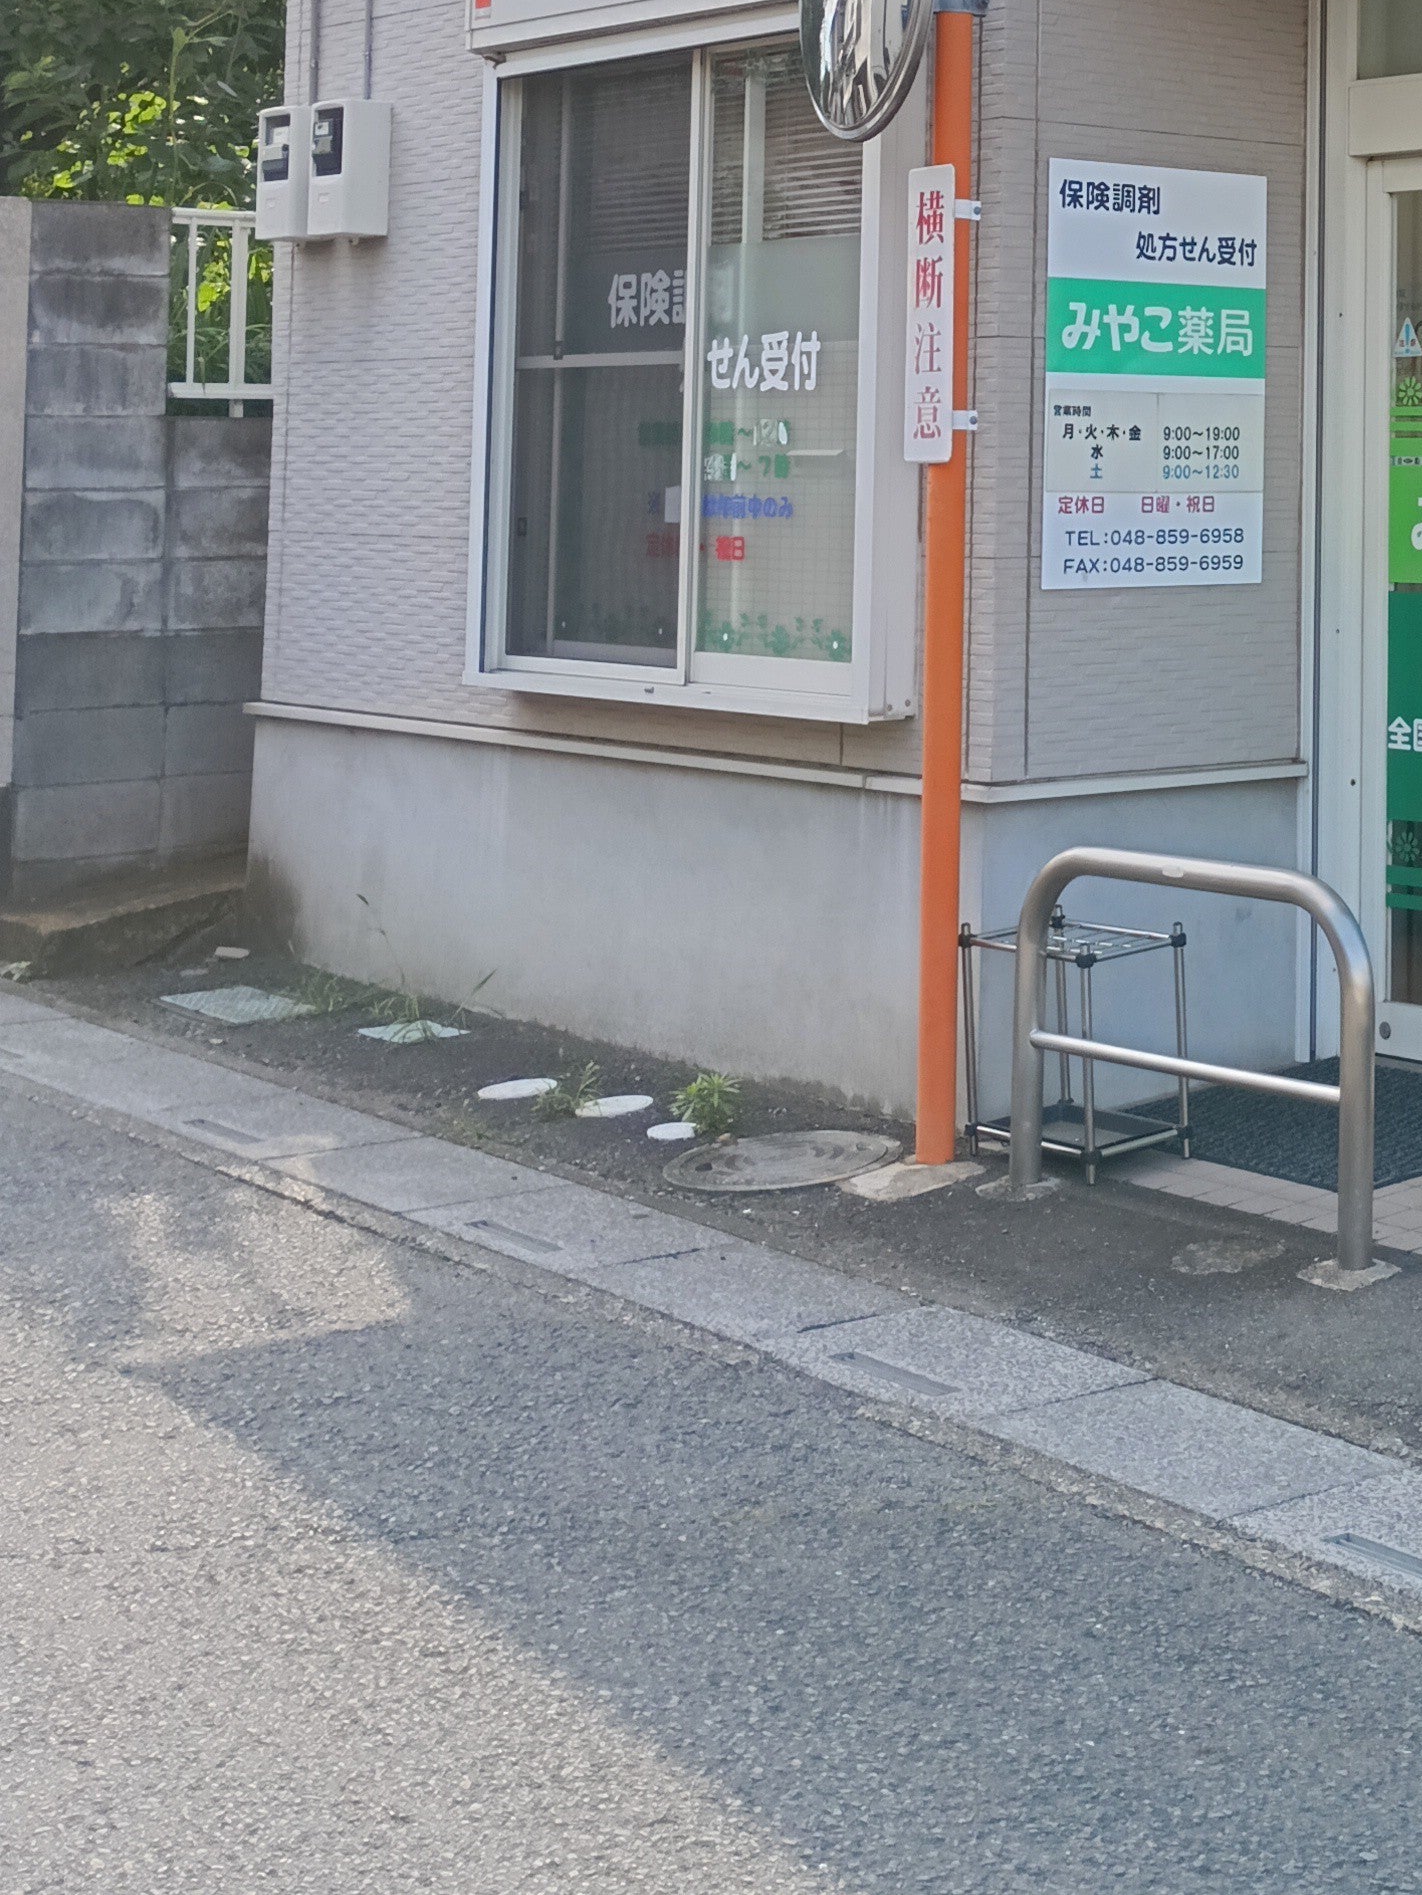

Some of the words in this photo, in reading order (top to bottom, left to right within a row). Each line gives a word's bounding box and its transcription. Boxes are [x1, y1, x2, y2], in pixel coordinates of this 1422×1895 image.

[1059, 178, 1161, 216] 保険調剤
[1135, 230, 1258, 268] 処方せん受付
[912, 190, 945, 440] 横断注意
[1060, 301, 1255, 357] みやこ薬局
[707, 330, 822, 392] せん受付
[1053, 404, 1092, 417] 営業時間
[1090, 444, 1104, 459] 水
[1089, 463, 1103, 479] 土
[1058, 495, 1105, 514] 定休日
[1141, 495, 1215, 514] 日曜・祝日
